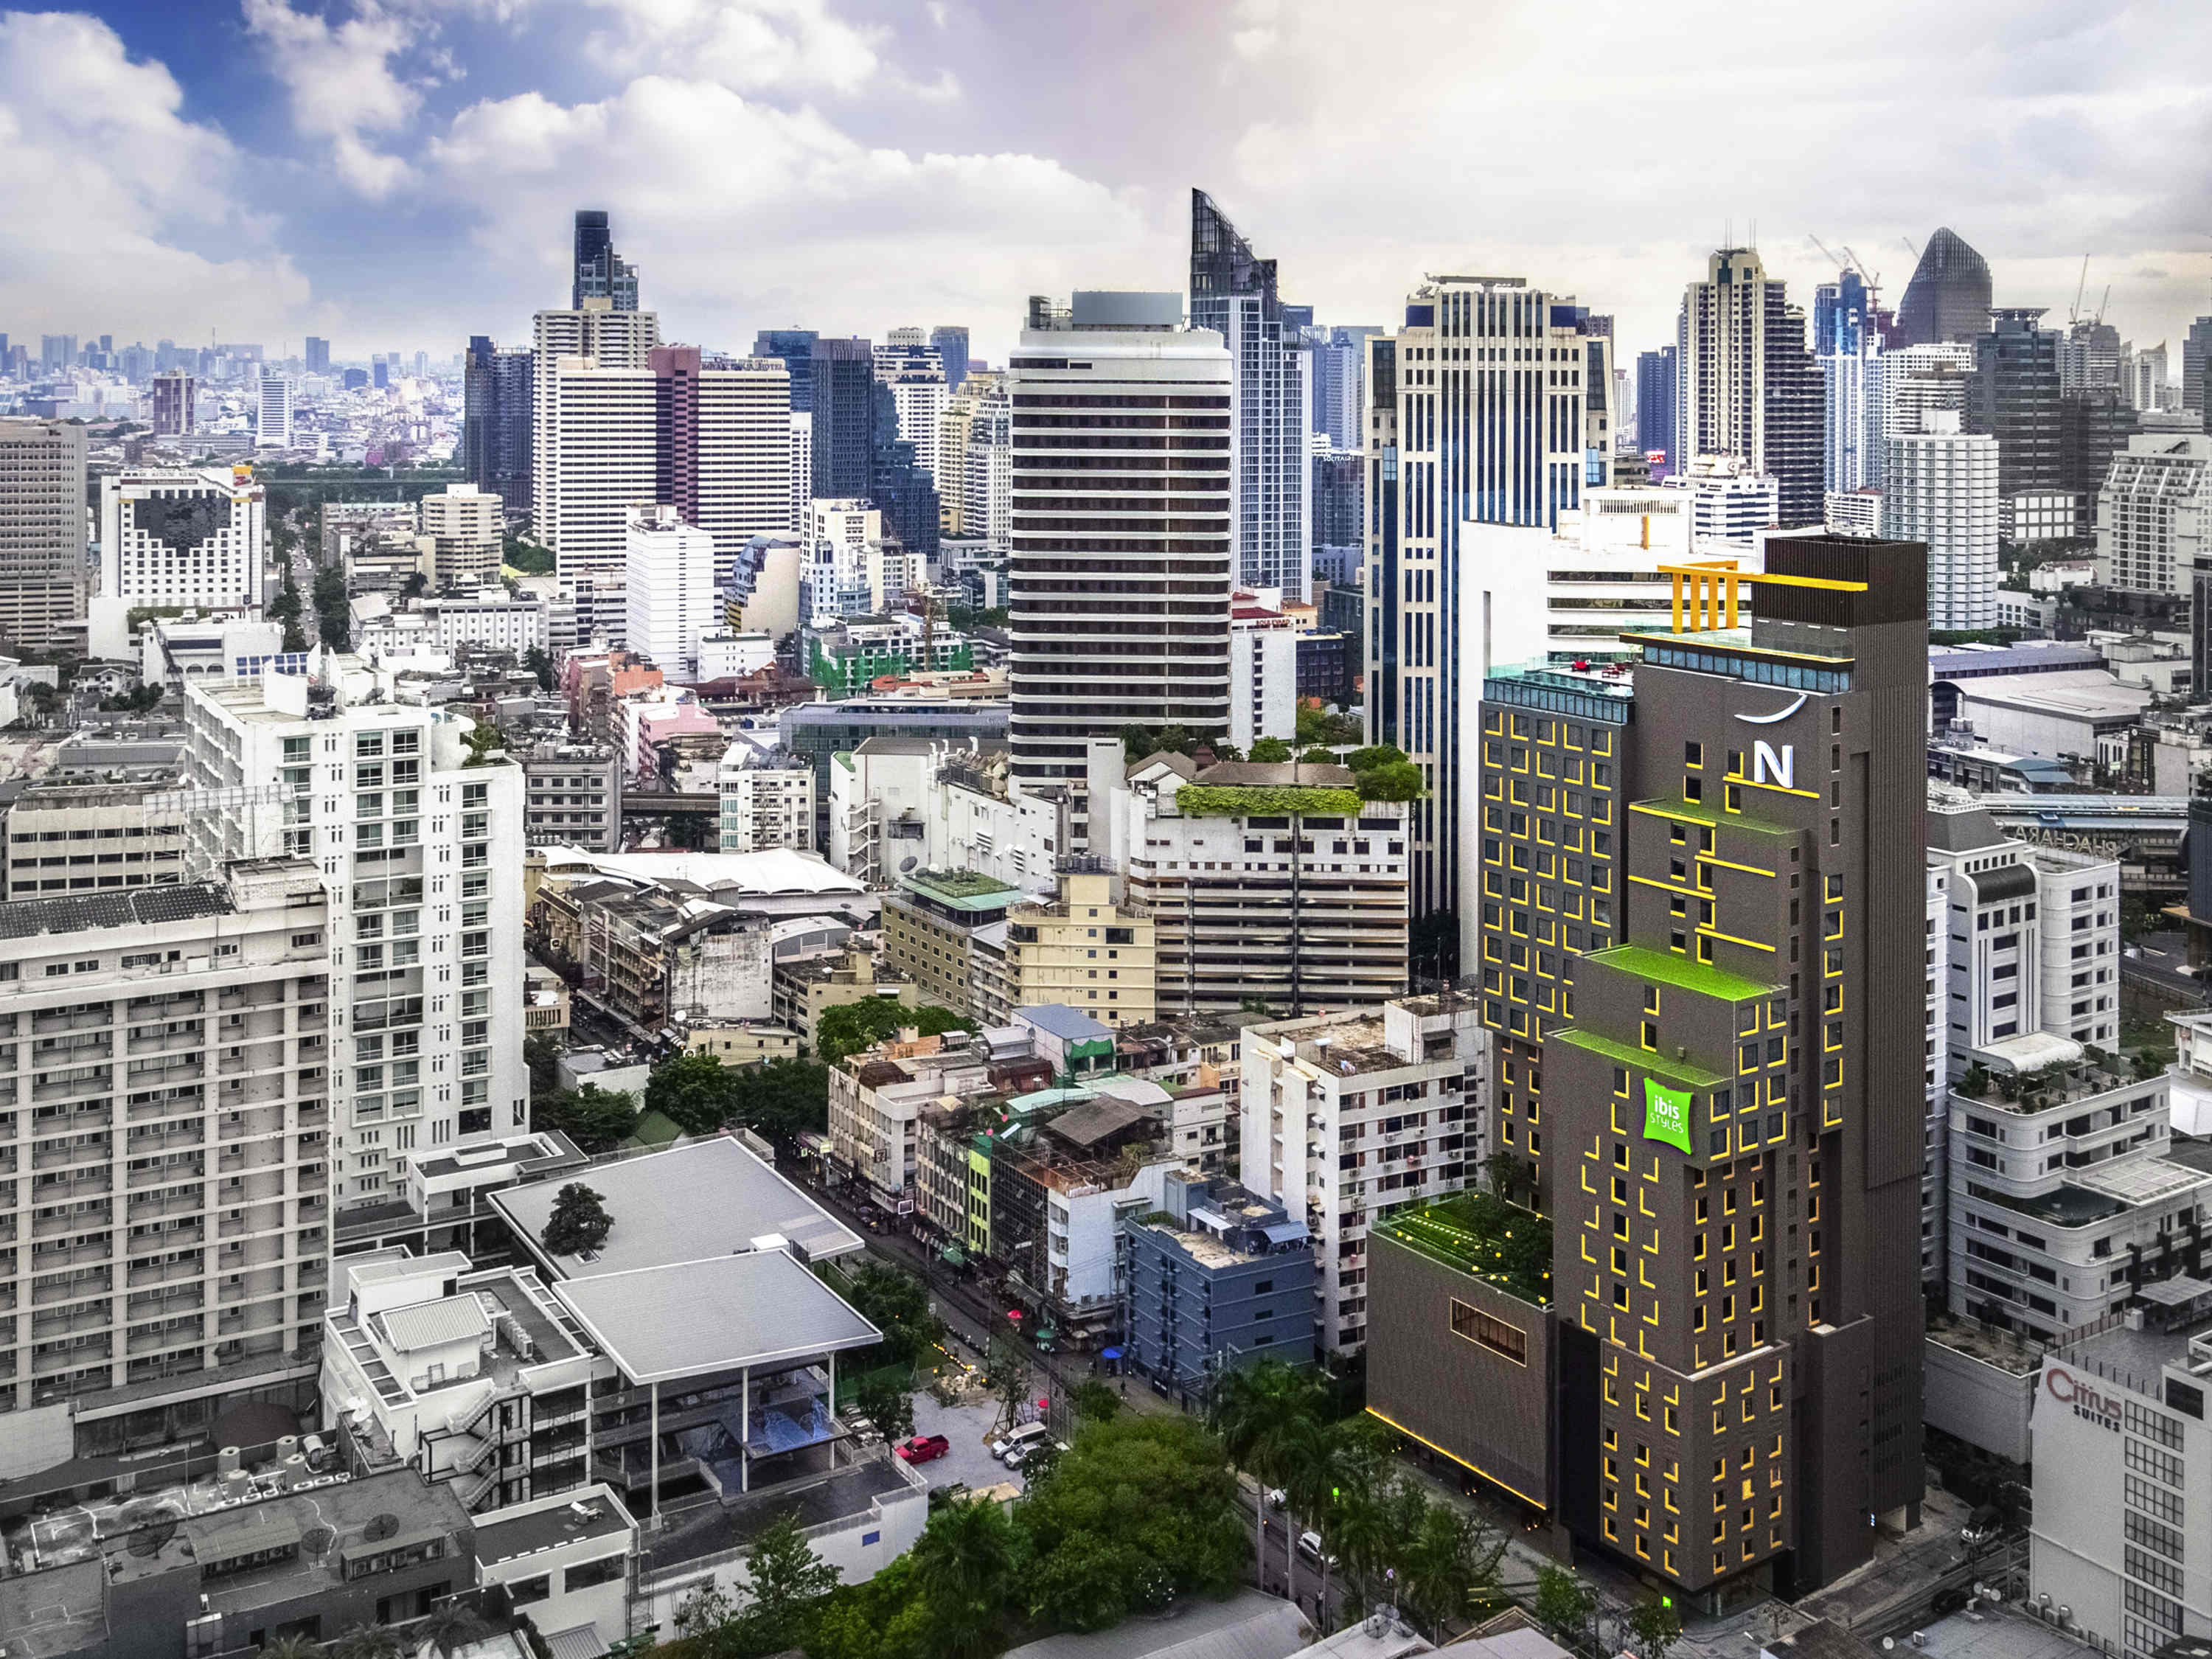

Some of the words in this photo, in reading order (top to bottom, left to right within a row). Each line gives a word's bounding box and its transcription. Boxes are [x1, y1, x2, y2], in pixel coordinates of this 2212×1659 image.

[1654, 1095, 1680, 1120] ibis
[2046, 1368, 2123, 1421] Citrus
[2073, 1404, 2121, 1433] SUITES
